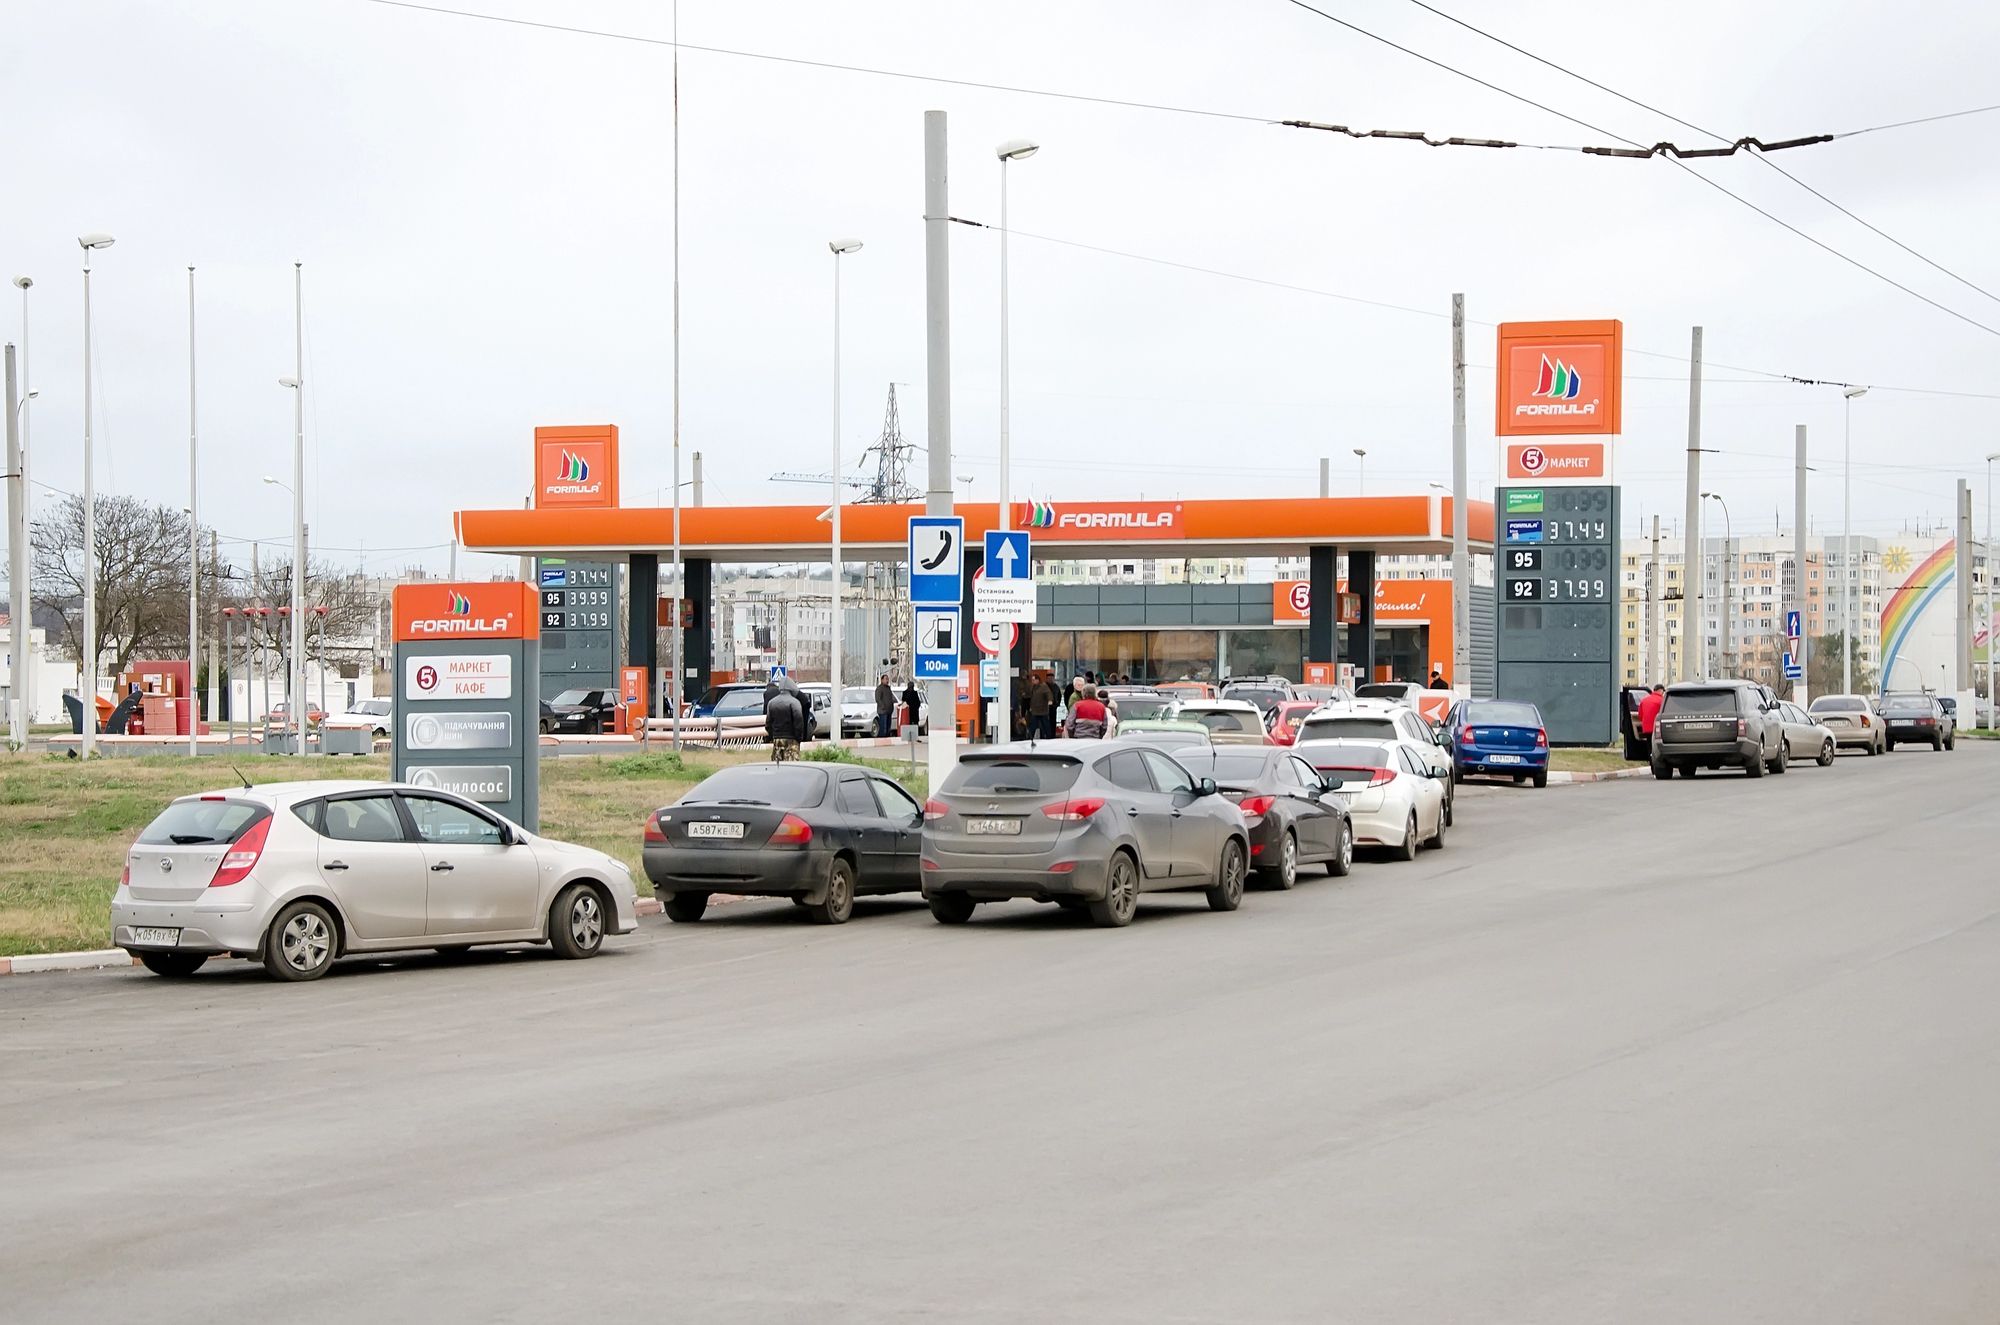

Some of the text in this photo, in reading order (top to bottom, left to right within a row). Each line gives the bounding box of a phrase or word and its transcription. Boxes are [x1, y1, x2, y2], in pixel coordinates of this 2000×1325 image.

[1515, 404, 1595, 416] FORMULA
[1549, 457, 1590, 468] МАРКЕТ
[546, 485, 599, 494] FORMULA
[1059, 512, 1173, 528] FORMULA
[1514, 552, 1534, 568] 95
[1514, 579, 1604, 598] 92 37.99
[547, 591, 608, 606] 95 39.99
[547, 612, 608, 627] 92 37.99
[410, 618, 508, 634] FORMULA
[449, 661, 492, 673] МАРКЕТ
[455, 682, 486, 694] КАФЕ
[444, 721, 505, 731] ПІДКАЧУВАННЯ
[444, 732, 463, 740] ШИН
